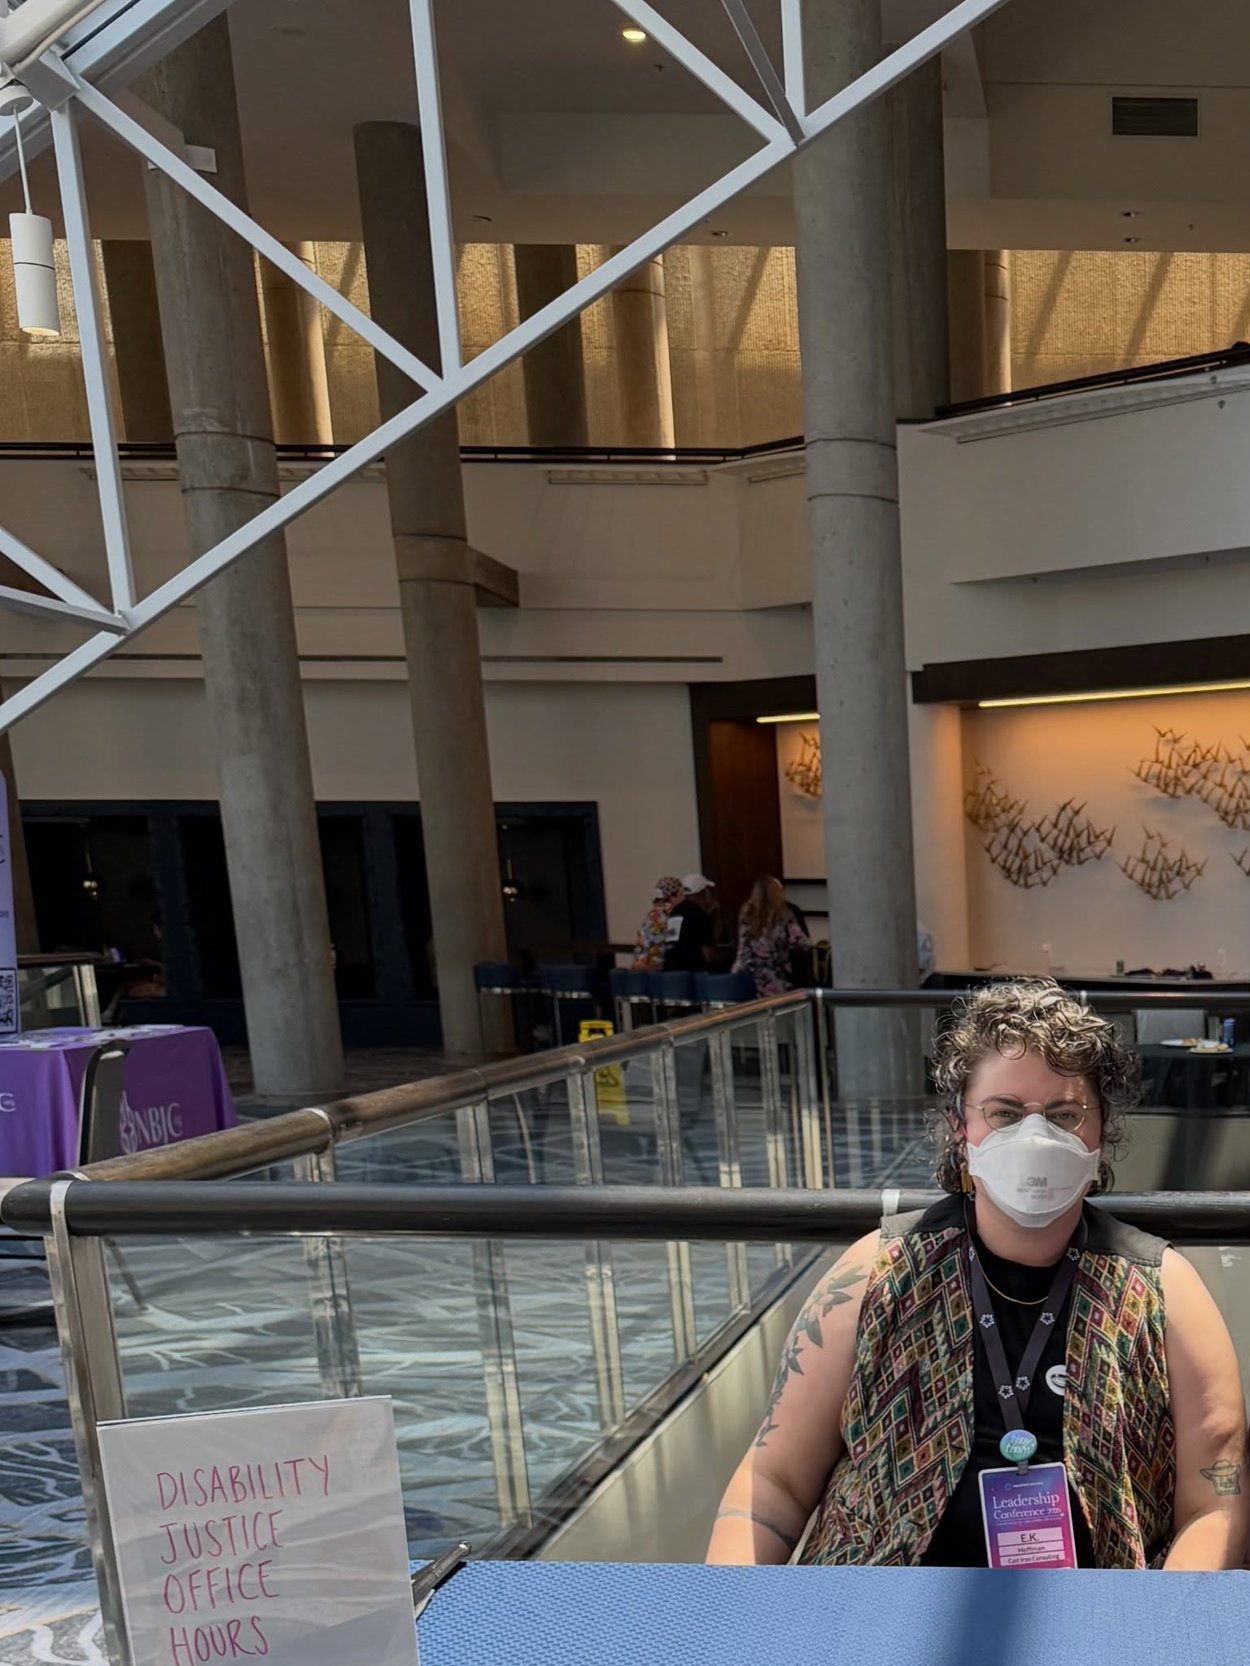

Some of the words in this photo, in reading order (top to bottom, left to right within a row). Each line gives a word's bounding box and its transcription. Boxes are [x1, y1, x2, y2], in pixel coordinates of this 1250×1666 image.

[1026, 1176, 1048, 1188] 3M
[156, 1455, 330, 1510] DISABILITY
[992, 1491, 1060, 1510] Leadership
[993, 1508, 1046, 1520] Conference
[160, 1509, 285, 1565] JUSTICE
[1020, 1532, 1040, 1544] E.K.
[1032, 1553, 1060, 1562] Consulting
[163, 1560, 280, 1615] OFFICE
